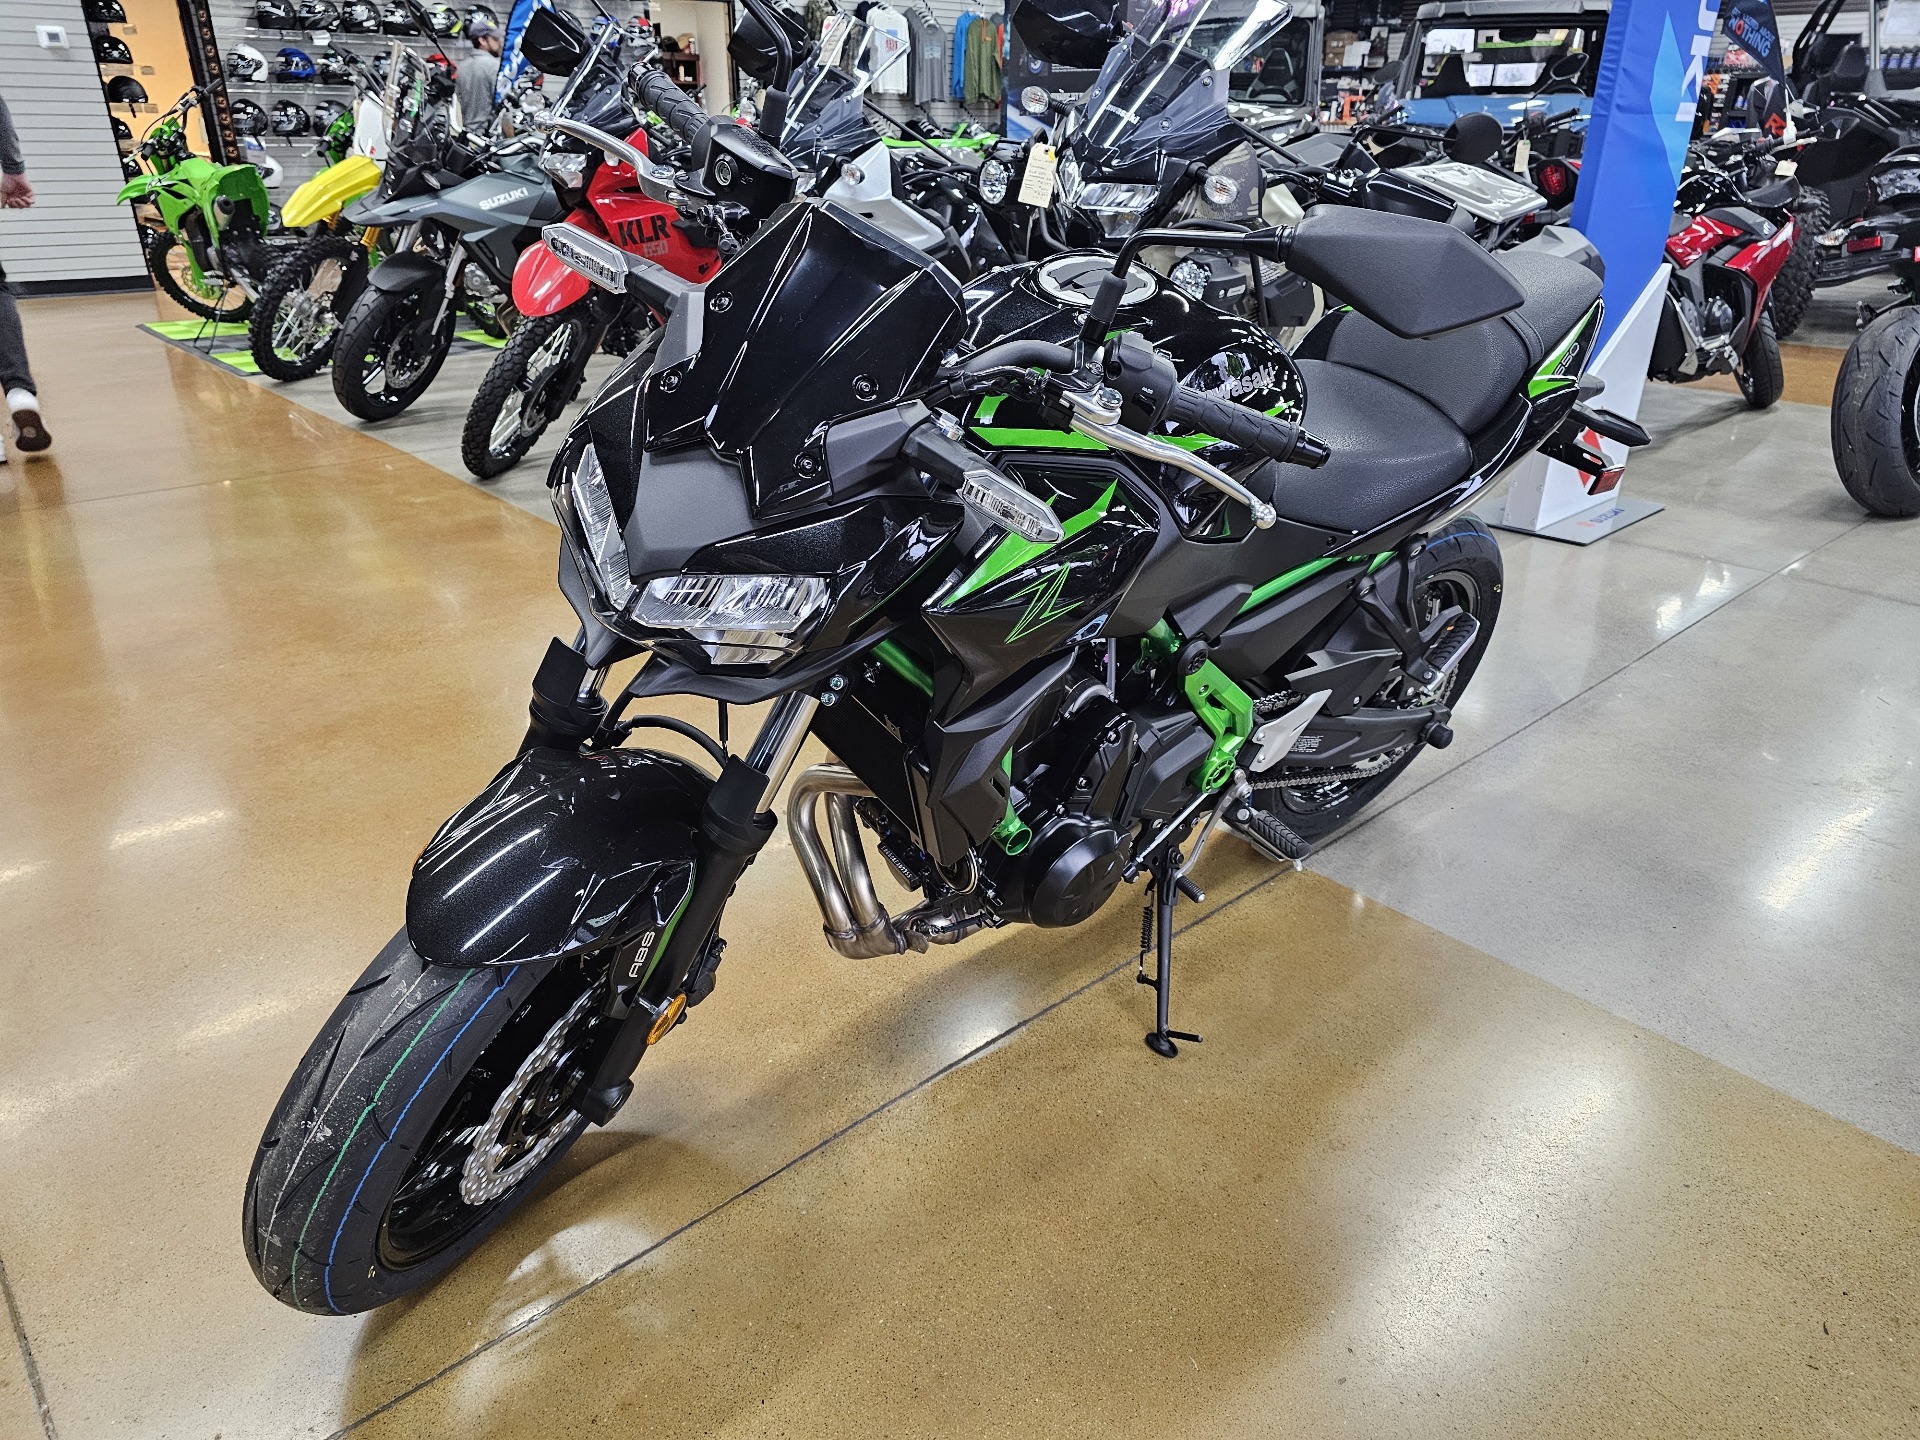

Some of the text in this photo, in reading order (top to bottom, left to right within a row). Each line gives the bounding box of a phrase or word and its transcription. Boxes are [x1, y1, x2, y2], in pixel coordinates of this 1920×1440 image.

[1728, 15, 1774, 58] NOTHING
[478, 186, 530, 211] SUZUKI
[617, 214, 671, 246] KLR
[643, 240, 669, 257] 650
[628, 931, 656, 978] ABS
